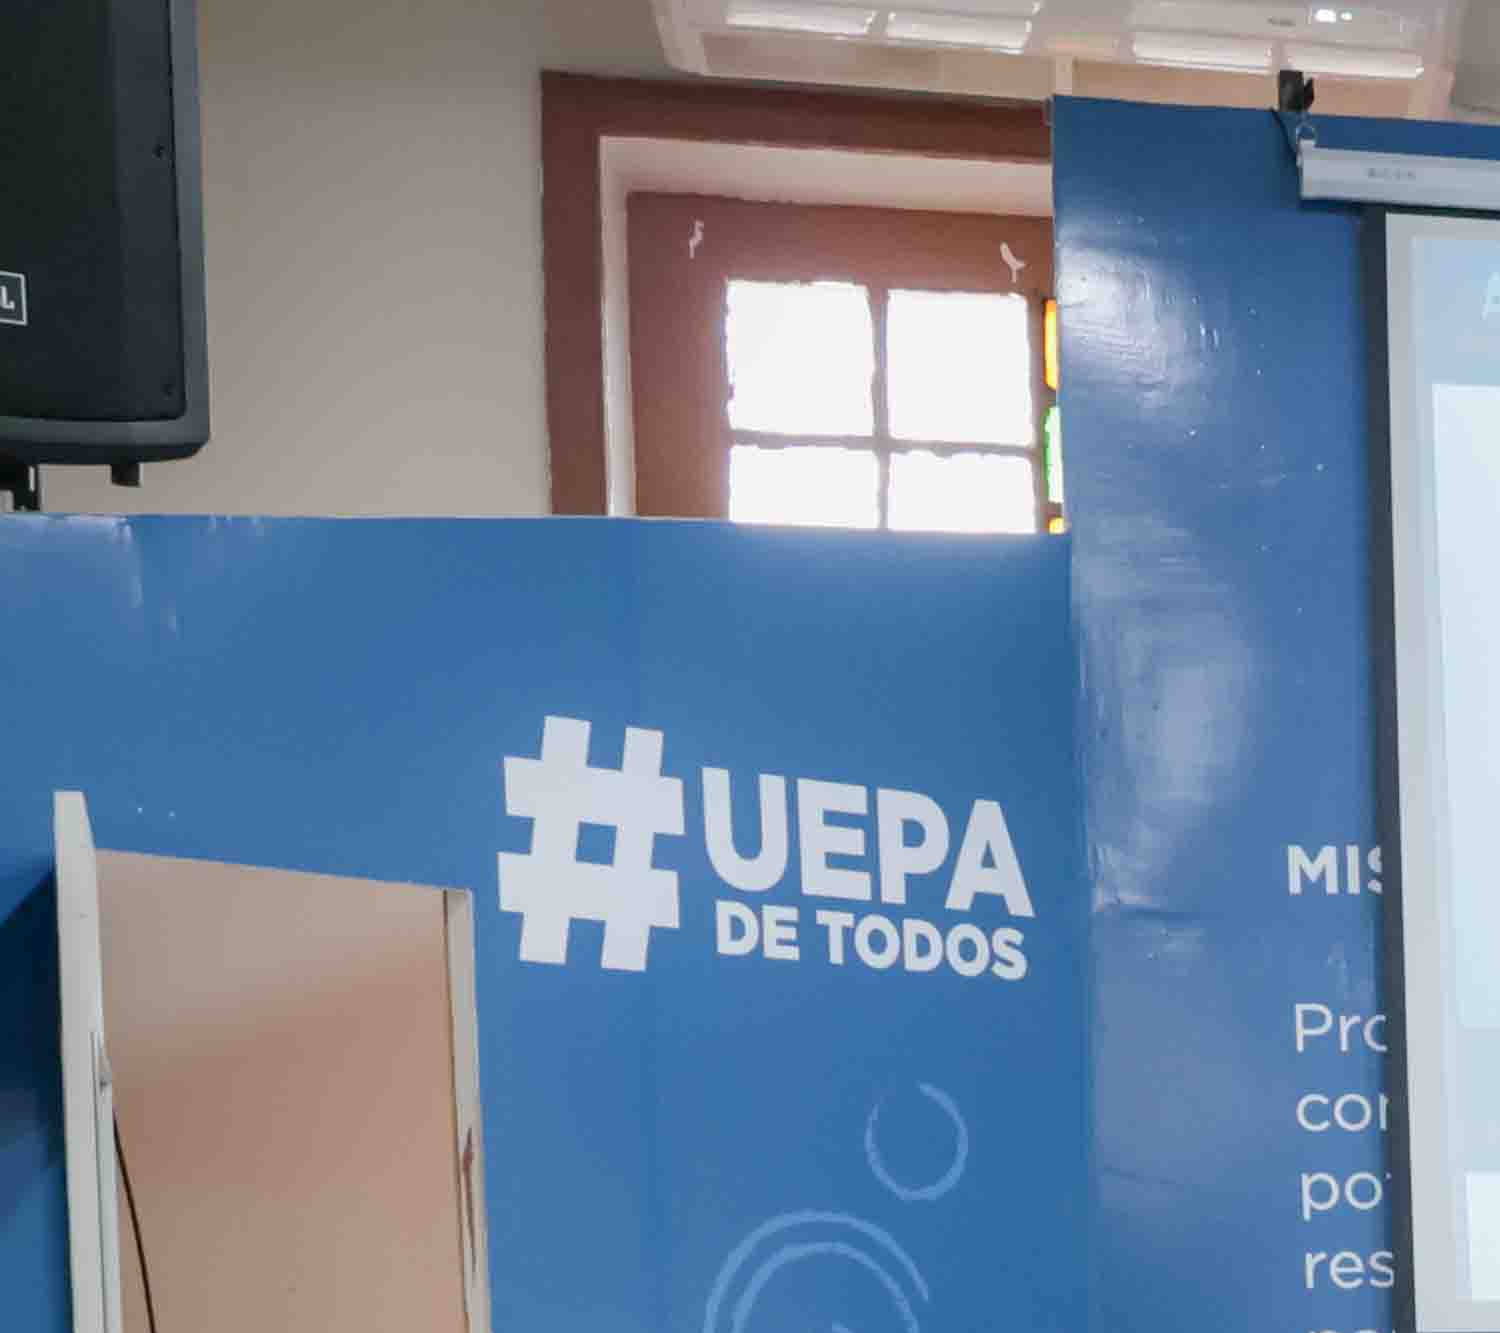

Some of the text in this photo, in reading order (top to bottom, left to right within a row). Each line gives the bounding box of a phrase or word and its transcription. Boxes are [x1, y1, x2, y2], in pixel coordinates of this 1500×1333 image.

[715, 900, 1030, 982] DE TODOS
[1300, 1172, 1392, 1221] po
